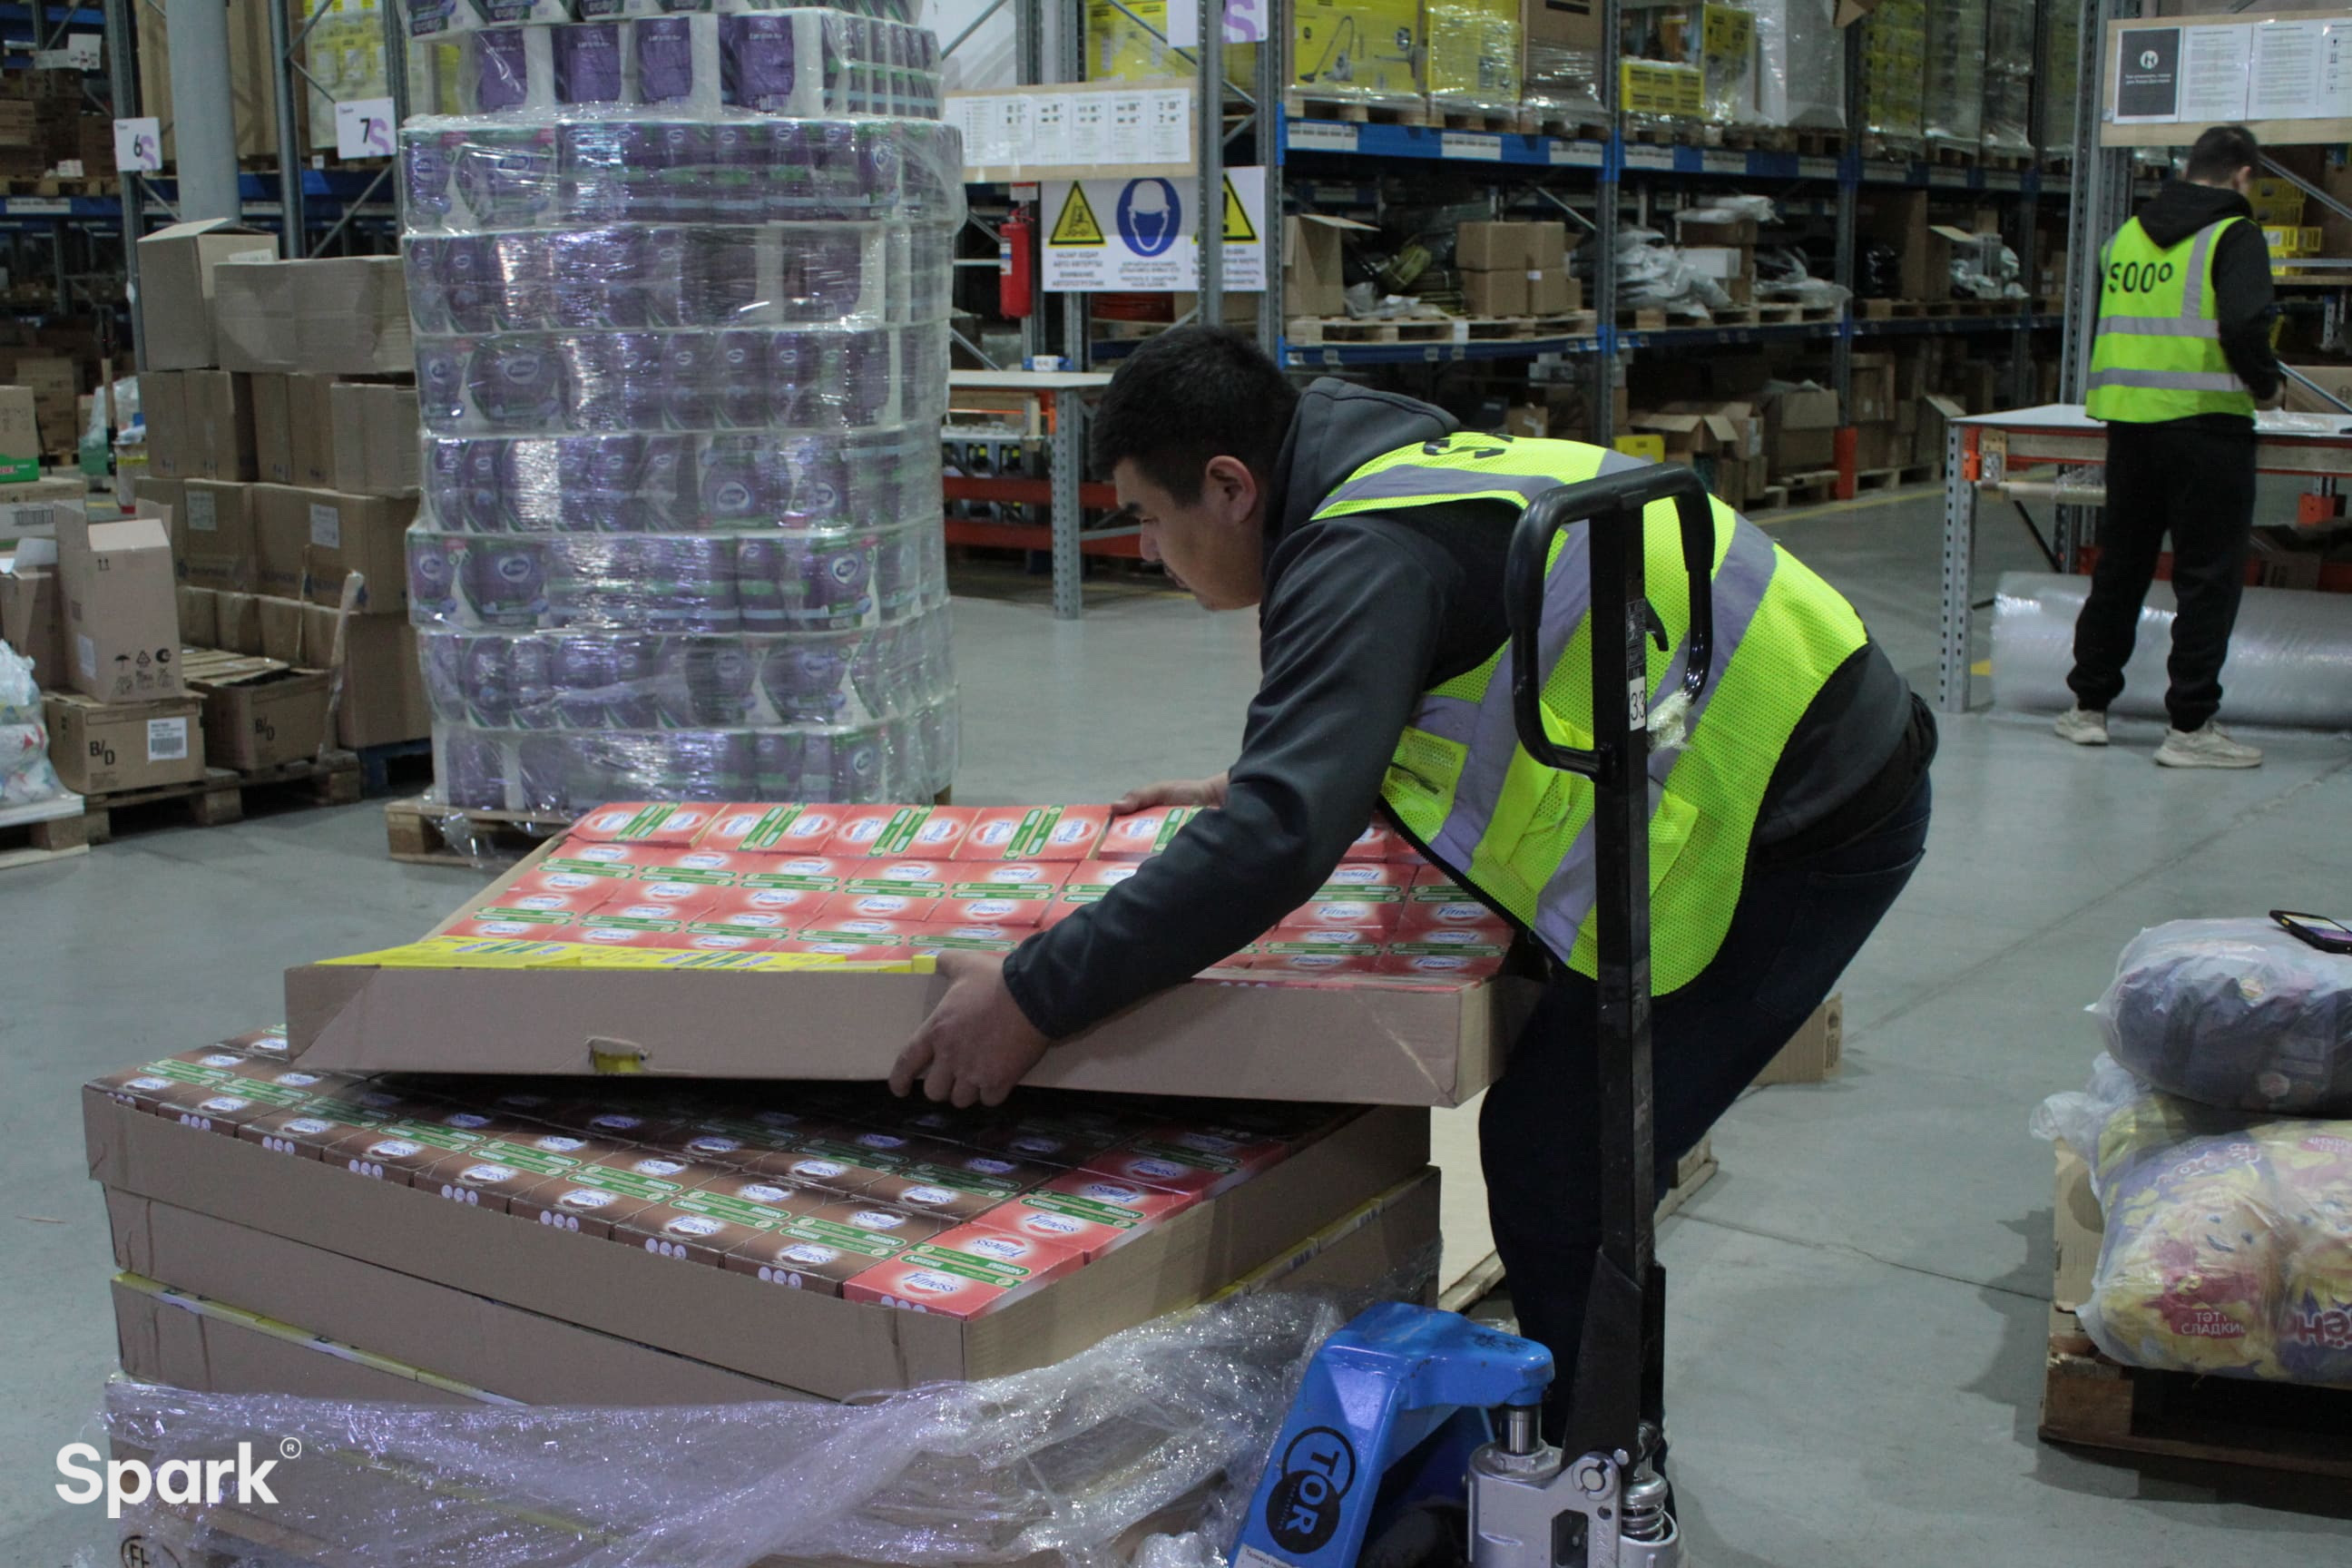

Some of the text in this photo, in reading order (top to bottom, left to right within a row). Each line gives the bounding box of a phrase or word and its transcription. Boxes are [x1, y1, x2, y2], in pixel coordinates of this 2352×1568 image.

[359, 118, 371, 143] 7
[133, 134, 143, 157] 6
[1631, 690, 1645, 721] 33
[89, 740, 116, 766] B/D
[1025, 1214, 1080, 1233] Fitness
[780, 1244, 834, 1262] Fitness
[974, 1240, 1027, 1258] Fitness
[903, 1273, 958, 1292] Fitness
[1286, 1451, 1340, 1534] TOR
